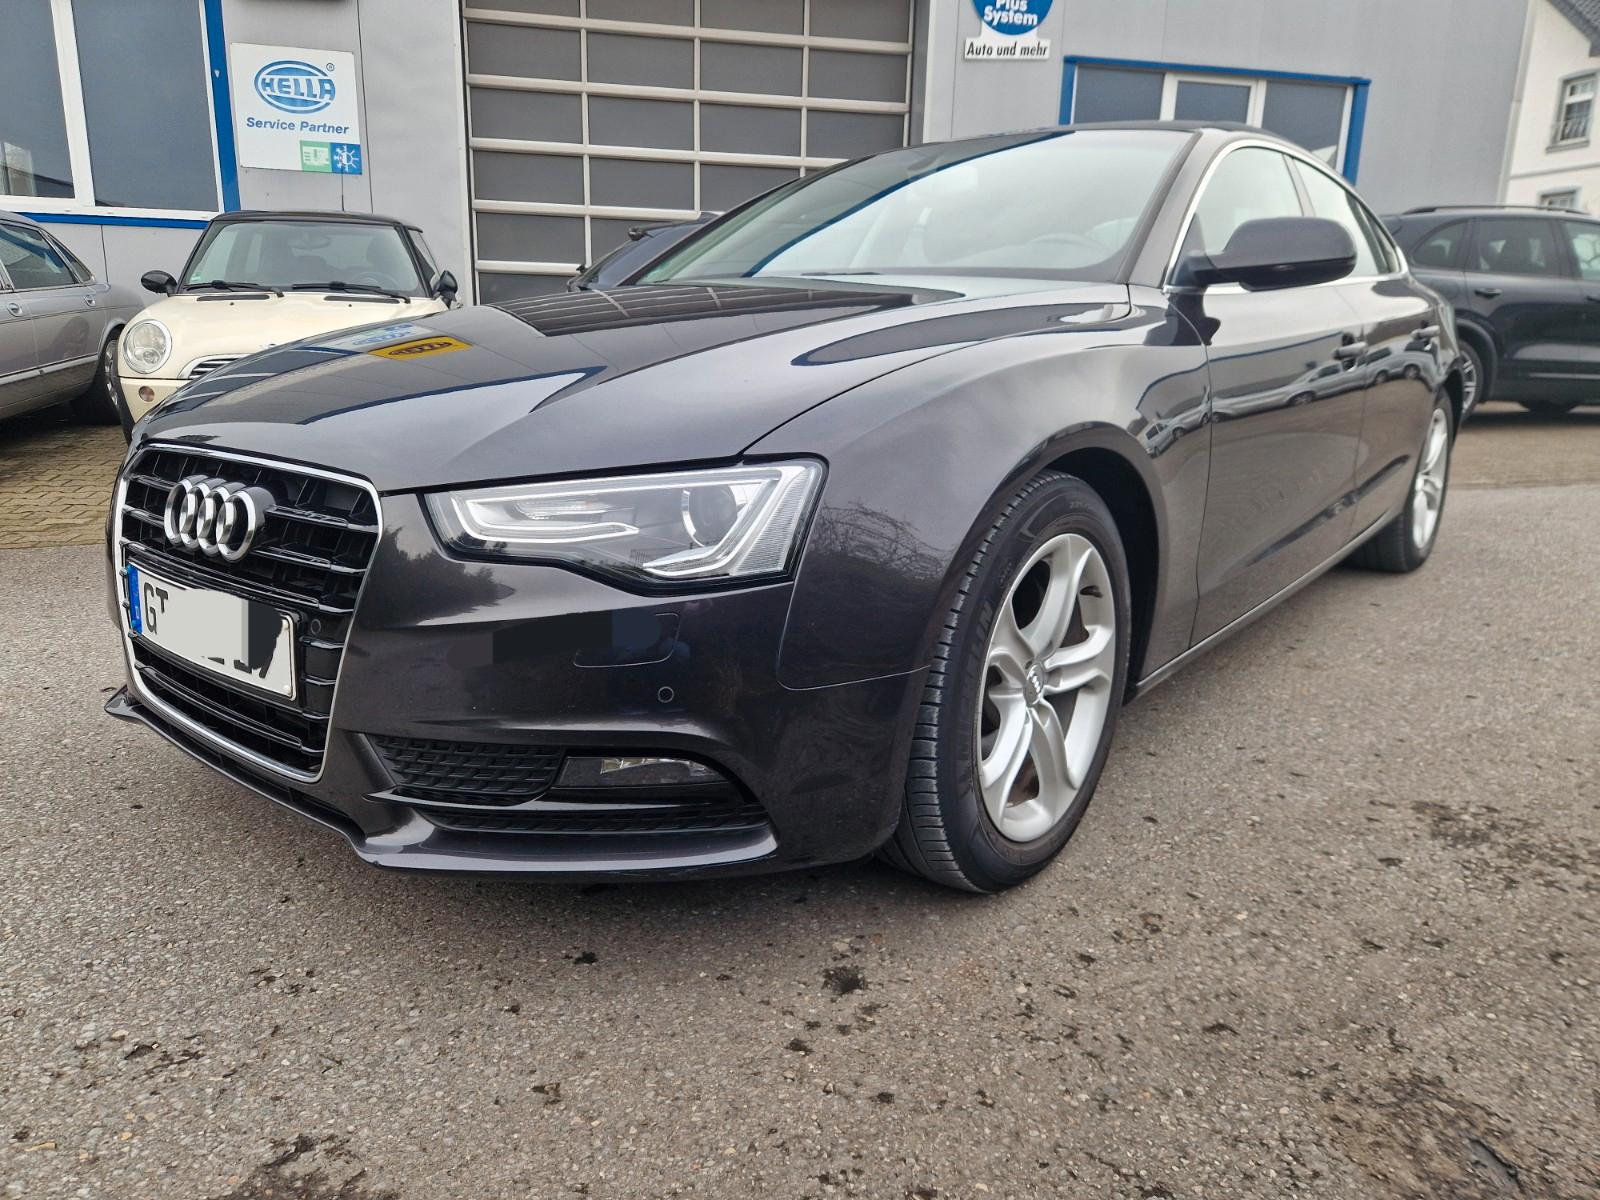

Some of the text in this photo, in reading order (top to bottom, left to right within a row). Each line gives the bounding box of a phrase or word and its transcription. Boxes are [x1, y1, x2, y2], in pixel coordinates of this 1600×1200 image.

[984, 5, 1038, 26] System
[967, 41, 1048, 56] Auto und mehr
[261, 77, 336, 101] HELLA
[246, 116, 349, 134] Service Partner
